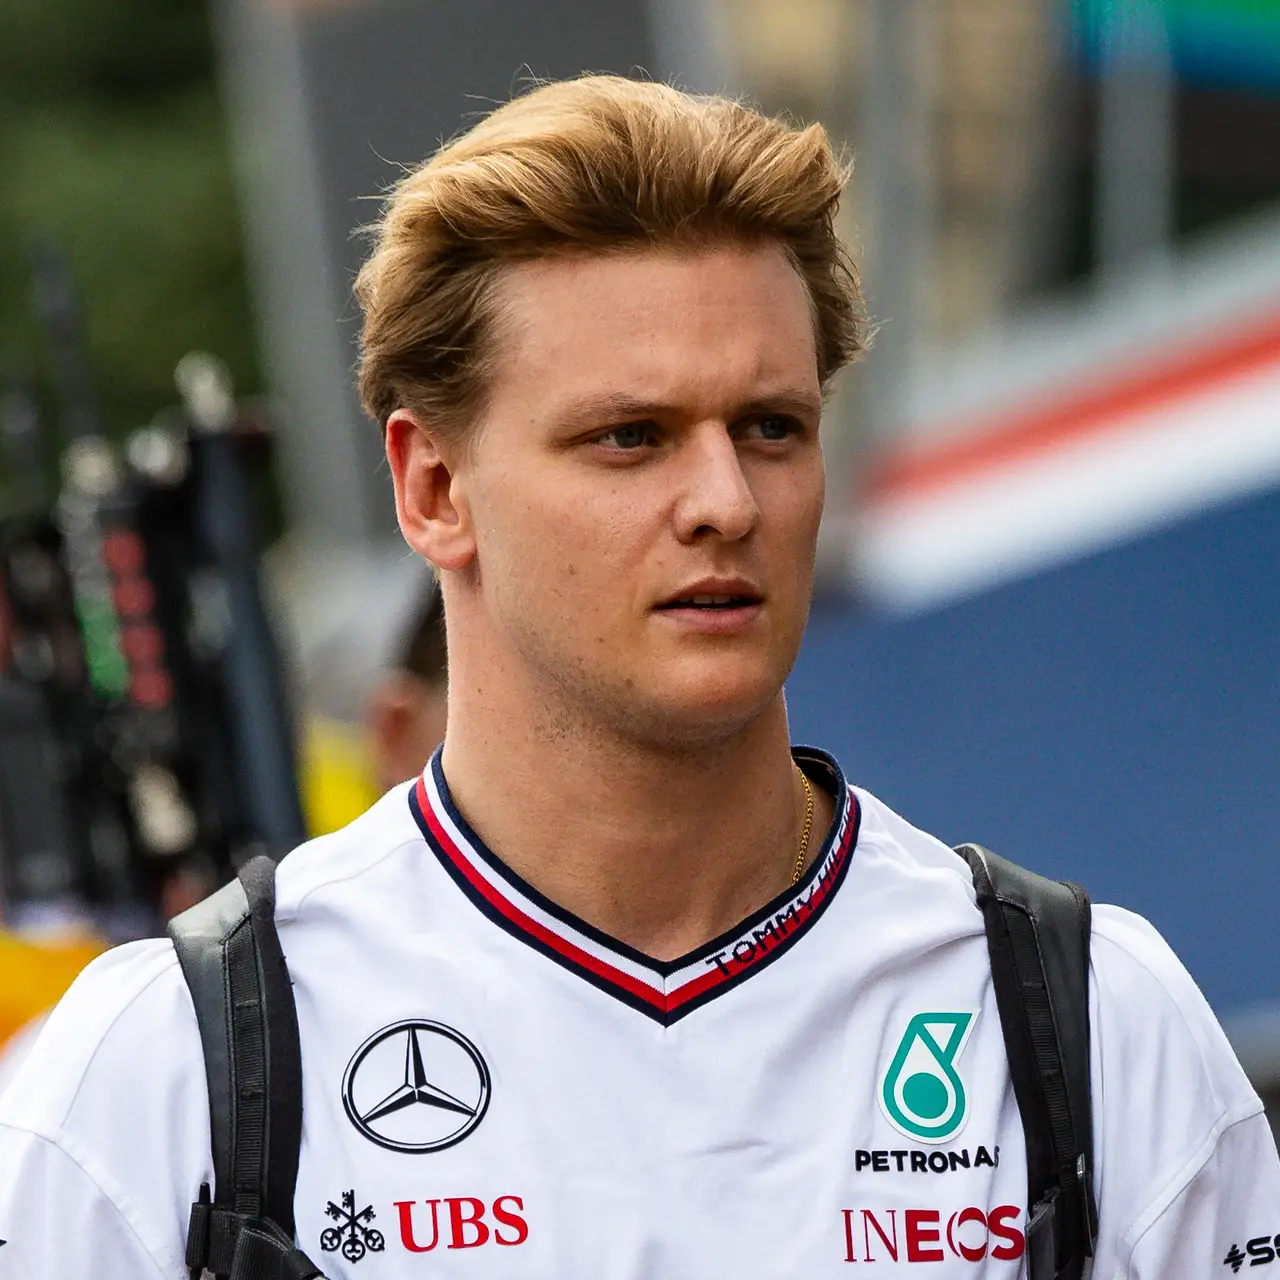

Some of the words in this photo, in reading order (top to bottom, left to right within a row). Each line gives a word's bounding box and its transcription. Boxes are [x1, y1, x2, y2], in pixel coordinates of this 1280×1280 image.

[704, 884, 815, 977] TOMMY
[393, 1195, 529, 1253] UBS
[841, 1205, 1026, 1262] INEOS
